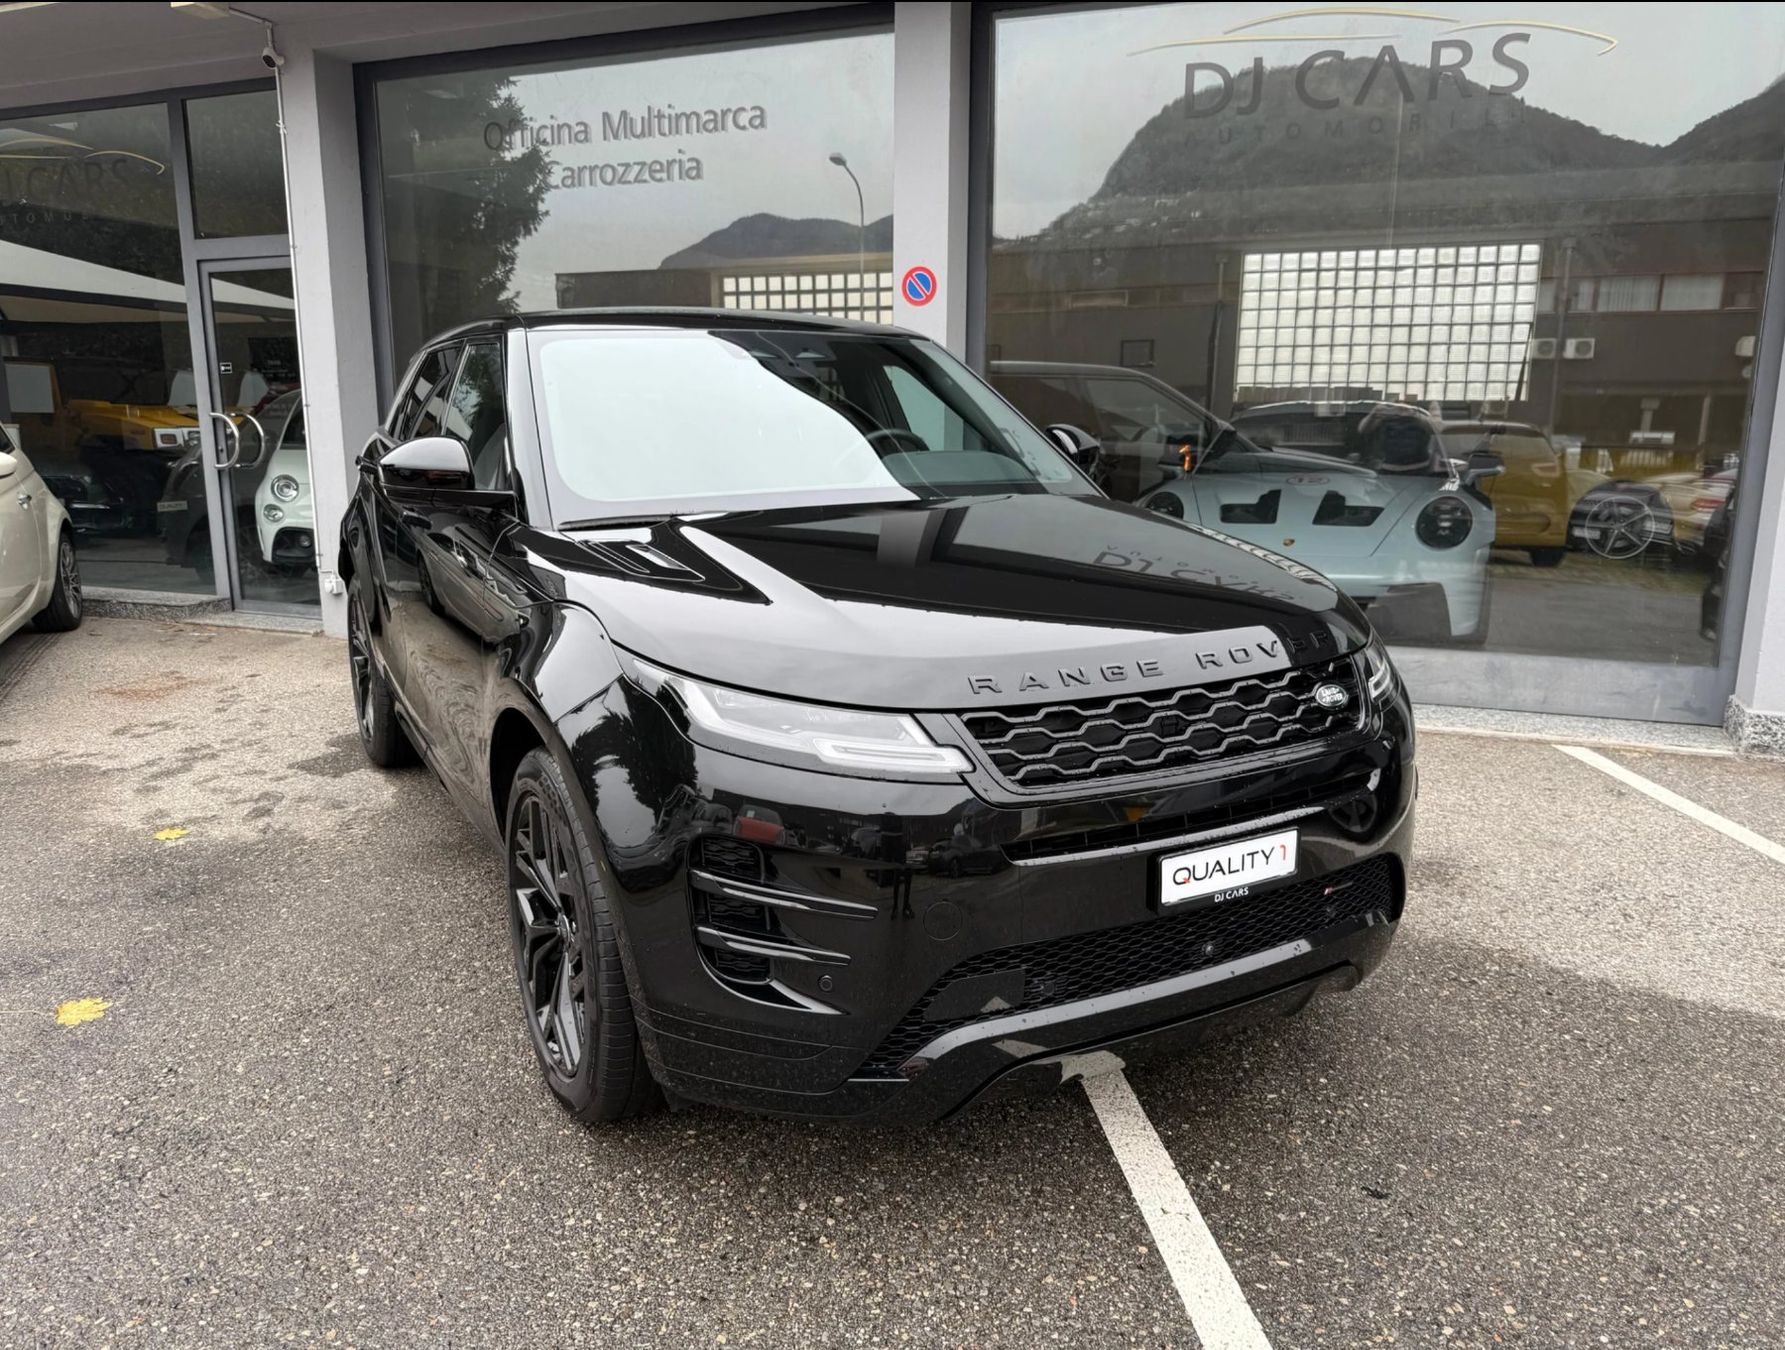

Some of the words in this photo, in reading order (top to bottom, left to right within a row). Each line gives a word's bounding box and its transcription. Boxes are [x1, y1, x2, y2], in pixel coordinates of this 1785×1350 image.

[1184, 56, 1263, 118] DJ
[1295, 32, 1532, 110] CARS
[484, 114, 592, 151] Officina
[602, 103, 767, 141] Multimarca
[546, 149, 704, 190] Carrozzeria
[967, 659, 1163, 694] RANGE
[1195, 630, 1328, 670] ROVER
[1172, 847, 1275, 886] QUALITY
[1279, 844, 1287, 861] 1
[1214, 893, 1225, 903] DJ
[1226, 886, 1249, 900] CARS
